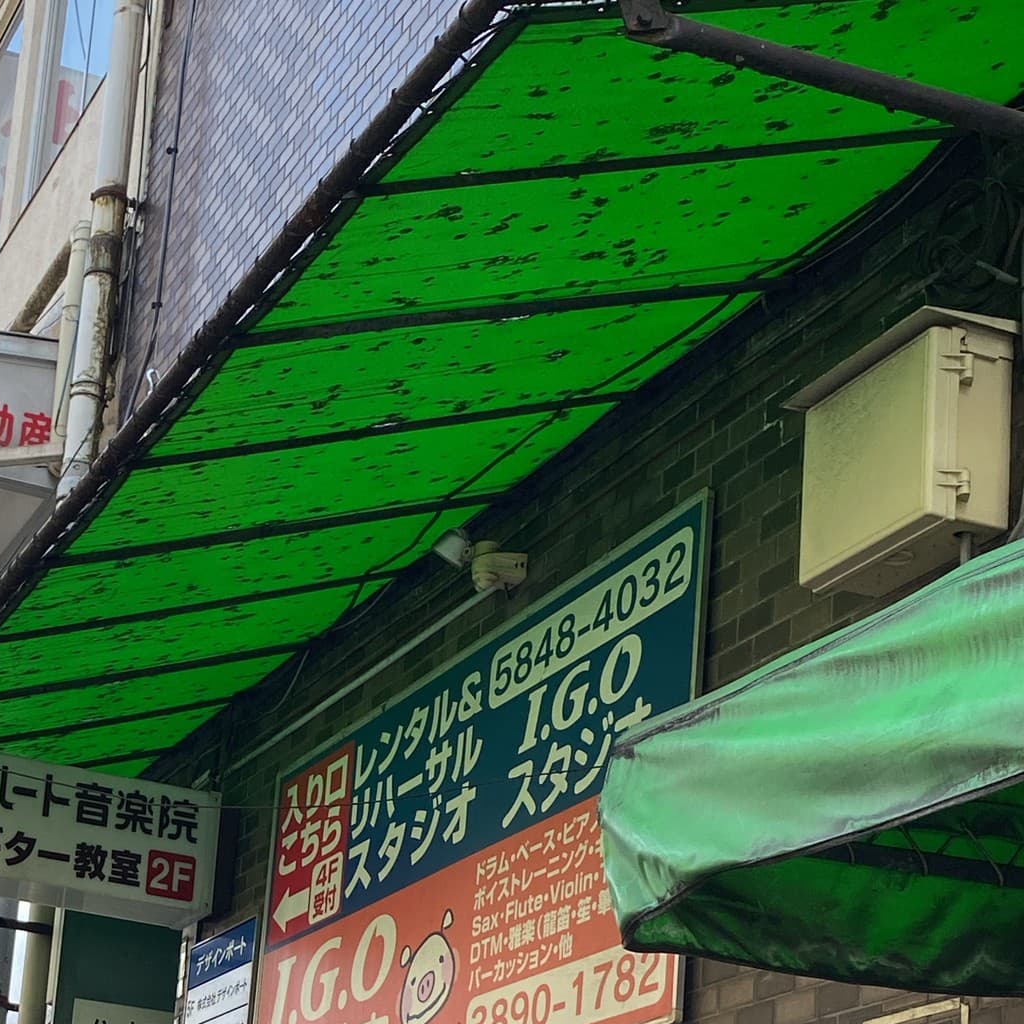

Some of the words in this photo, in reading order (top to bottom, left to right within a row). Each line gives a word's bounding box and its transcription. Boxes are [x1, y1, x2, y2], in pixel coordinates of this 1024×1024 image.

[494, 541, 687, 697] 5848-4032
[354, 671, 483, 790] レンタル&
[518, 633, 643, 755] I.G.O
[281, 754, 349, 833] 入り口
[351, 725, 483, 840] リハーサル
[149, 856, 194, 893] 2F
[278, 806, 342, 876] こちら
[315, 857, 339, 886] 4F
[345, 781, 477, 898] スタジオ
[312, 884, 337, 919] 受付
